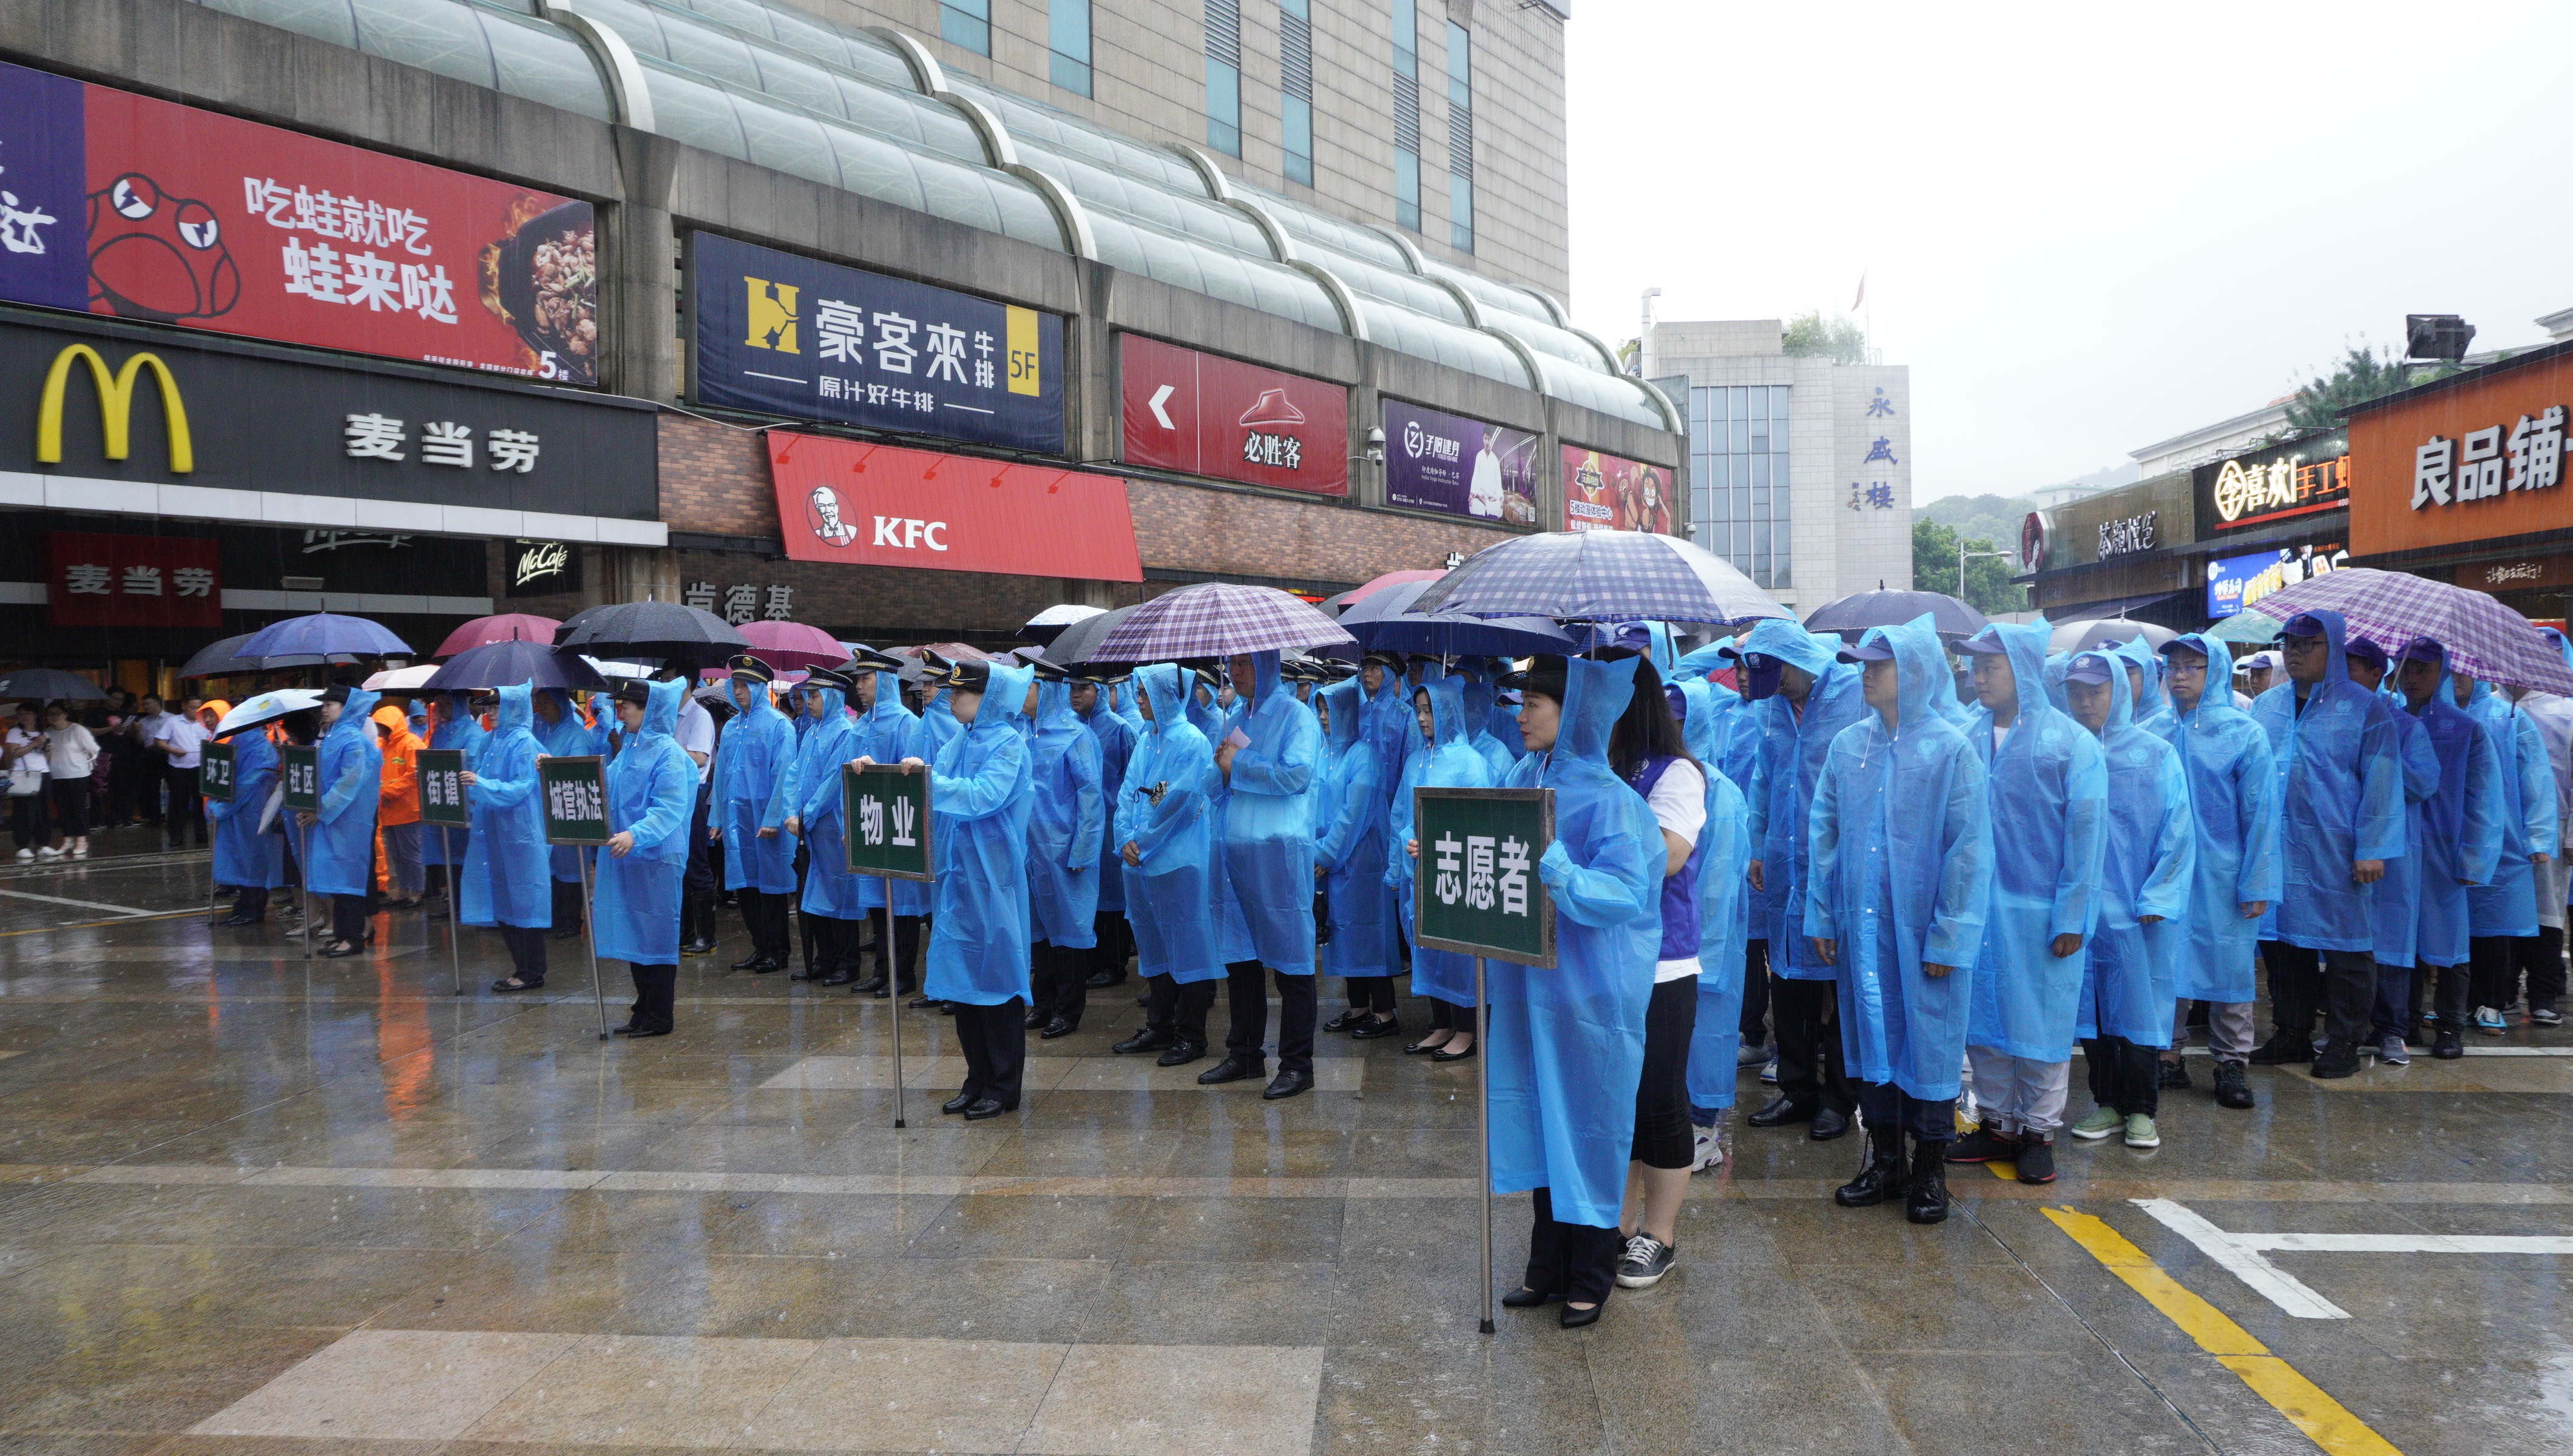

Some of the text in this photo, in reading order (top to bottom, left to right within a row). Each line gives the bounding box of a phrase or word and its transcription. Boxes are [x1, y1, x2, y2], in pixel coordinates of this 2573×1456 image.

[243, 177, 432, 257] 吃蛙就吃
[282, 237, 458, 324] 蛙来哒
[816, 299, 968, 384] 豪客來
[975, 331, 995, 389] 牛排
[1010, 350, 1036, 380] 5F
[819, 375, 934, 413] 原汁好牛排
[345, 413, 540, 473] 麦当劳
[1243, 430, 1302, 470] 必胜客
[2410, 405, 2573, 511] 良品铺
[873, 516, 948, 551] KFC
[2098, 511, 2156, 561] 茶颜悦色
[65, 562, 214, 598] 麦当劳
[516, 543, 568, 584] McCafé
[686, 581, 794, 624] 肯德基
[206, 757, 230, 786] 环卫
[289, 764, 314, 795] 社区
[427, 770, 460, 806] 街镇
[549, 780, 603, 822] 城管执法
[860, 794, 916, 847] 物业
[1435, 831, 1530, 917] 志愿者
